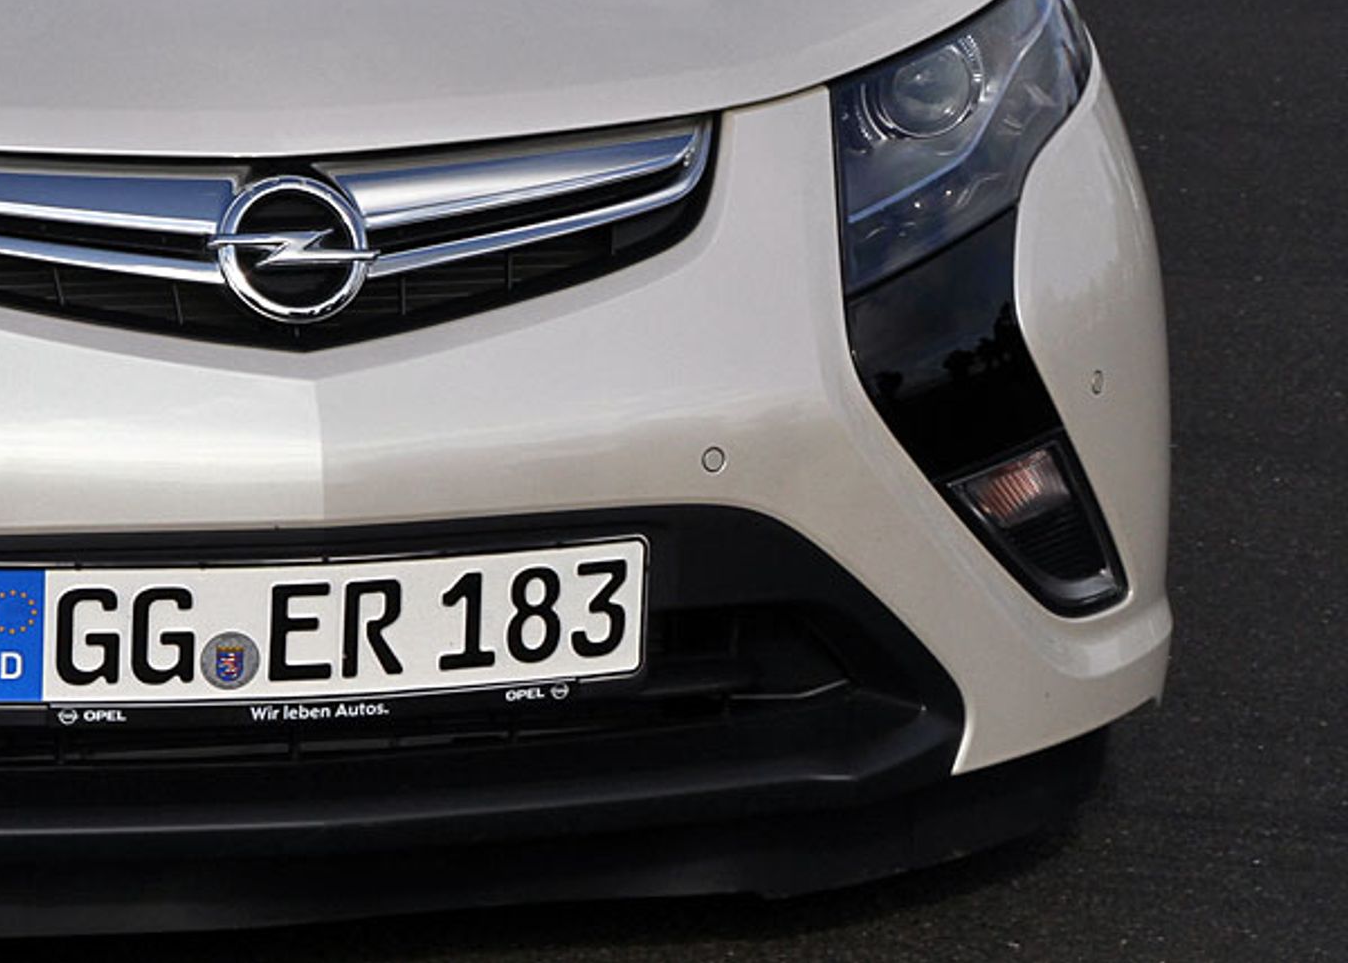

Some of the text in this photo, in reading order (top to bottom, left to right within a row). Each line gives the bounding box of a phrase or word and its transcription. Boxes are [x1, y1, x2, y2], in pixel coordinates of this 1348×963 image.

[55, 559, 628, 686] GG ER 183
[0, 652, 22, 680] D
[505, 687, 545, 702] OPEL
[83, 710, 127, 722] OPEL
[251, 702, 390, 721] Wir leben Autos.
